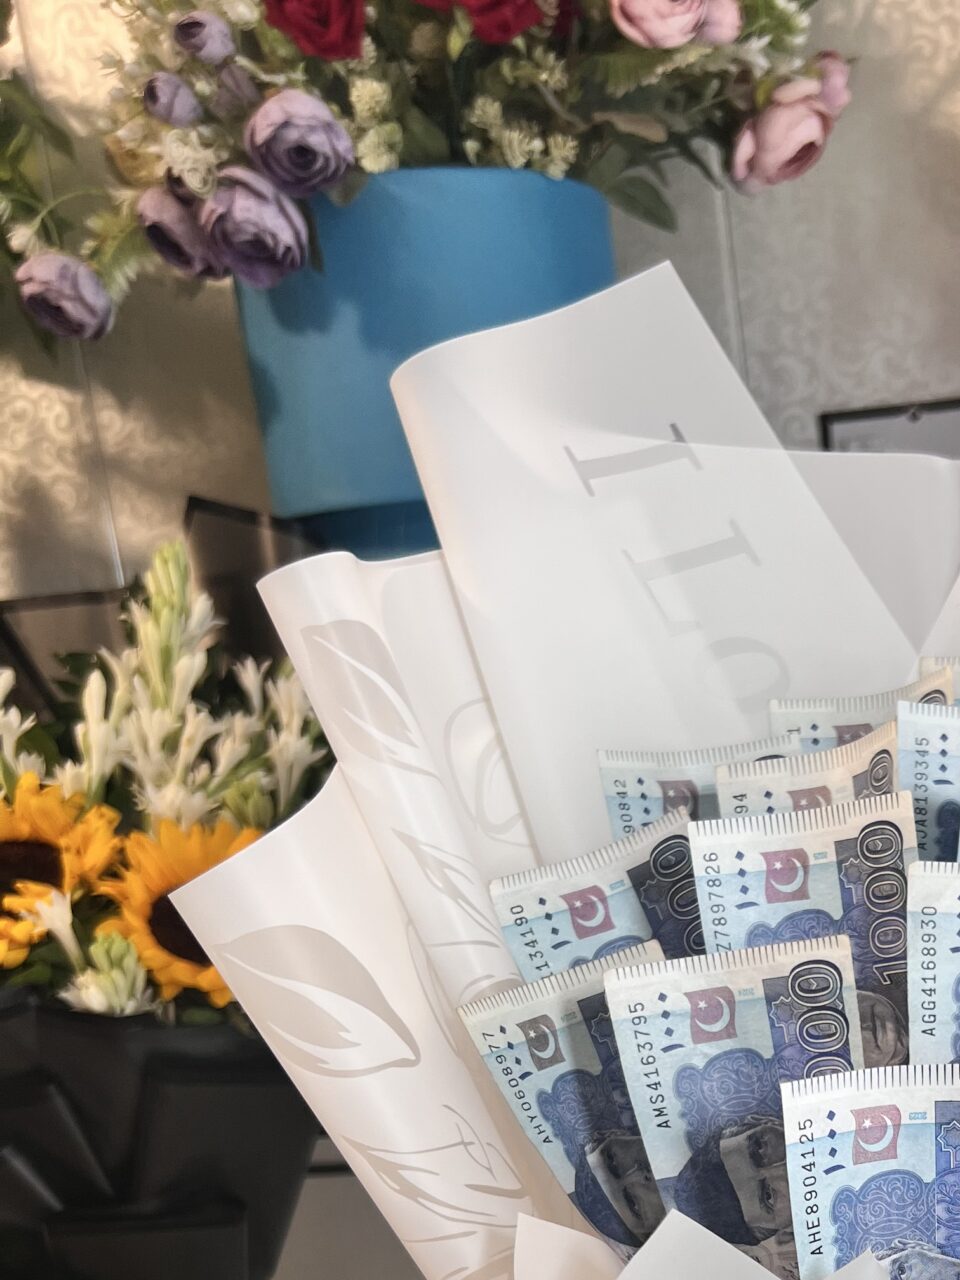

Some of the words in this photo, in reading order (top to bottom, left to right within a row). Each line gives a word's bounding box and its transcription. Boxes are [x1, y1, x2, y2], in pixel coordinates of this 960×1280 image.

[913, 737, 930, 851] AJA8139345
[921, 906, 937, 1037] AGG4168930
[482, 1031, 553, 1144] AHY0608977
[628, 1002, 672, 1129] AMS4163795
[798, 1118, 824, 1256] AHE8904125
